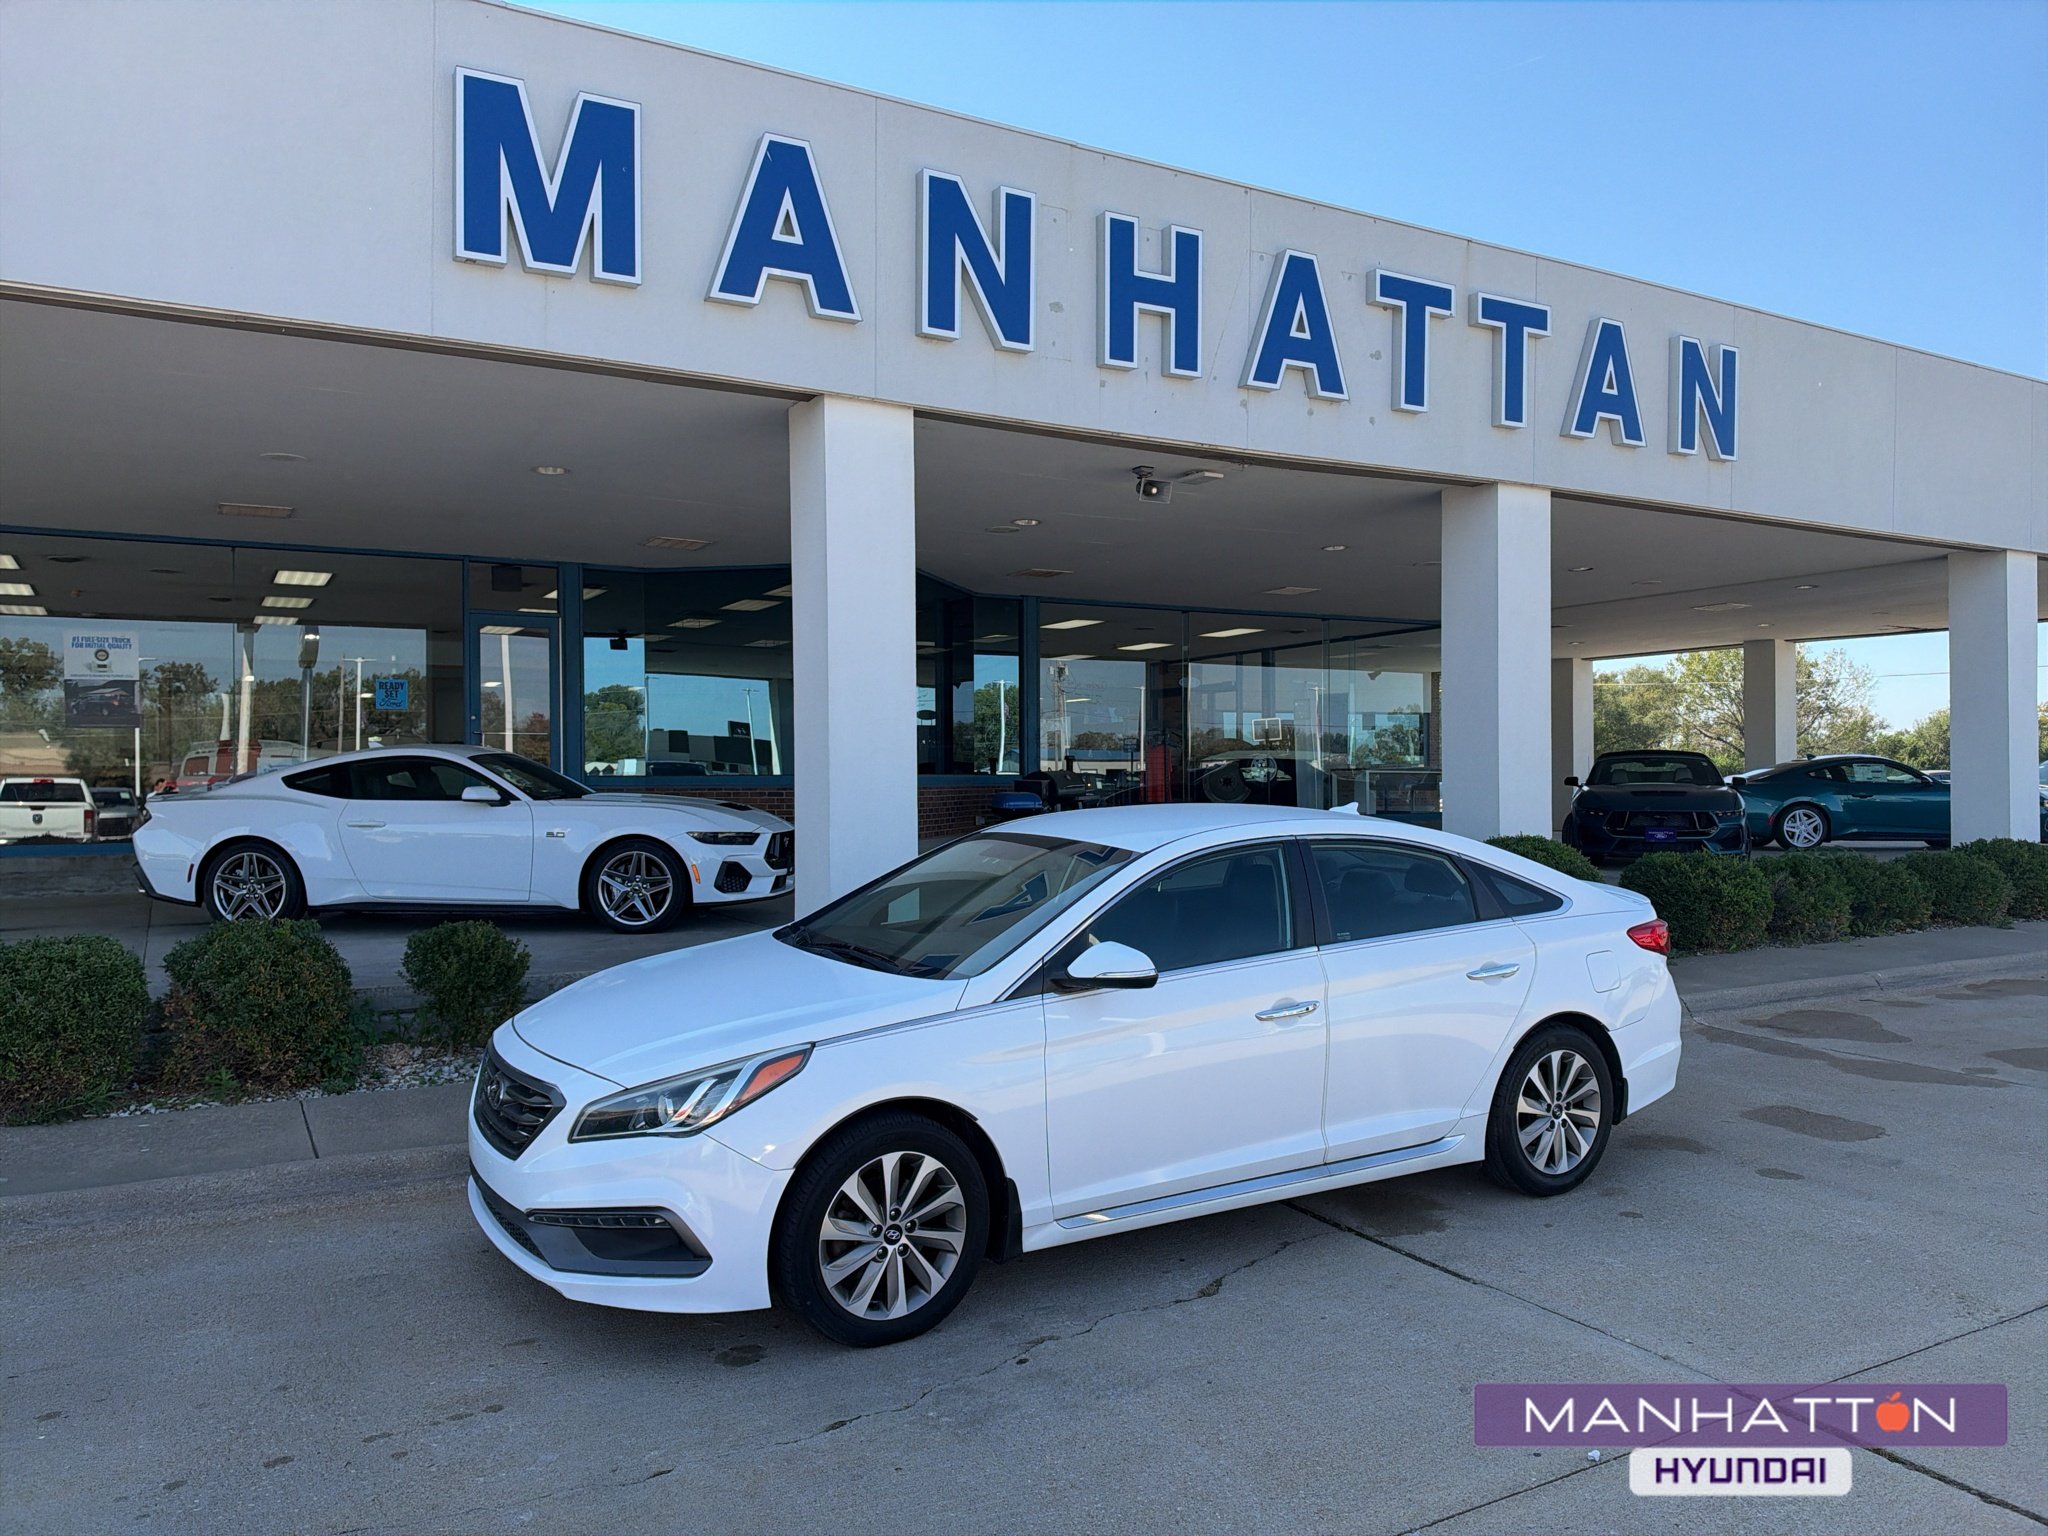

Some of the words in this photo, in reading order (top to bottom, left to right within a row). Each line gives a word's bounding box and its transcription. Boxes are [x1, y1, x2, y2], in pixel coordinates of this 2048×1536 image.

[453, 66, 1740, 463] MANHATTAN
[379, 682, 405, 690] READY
[379, 698, 403, 707] Ford
